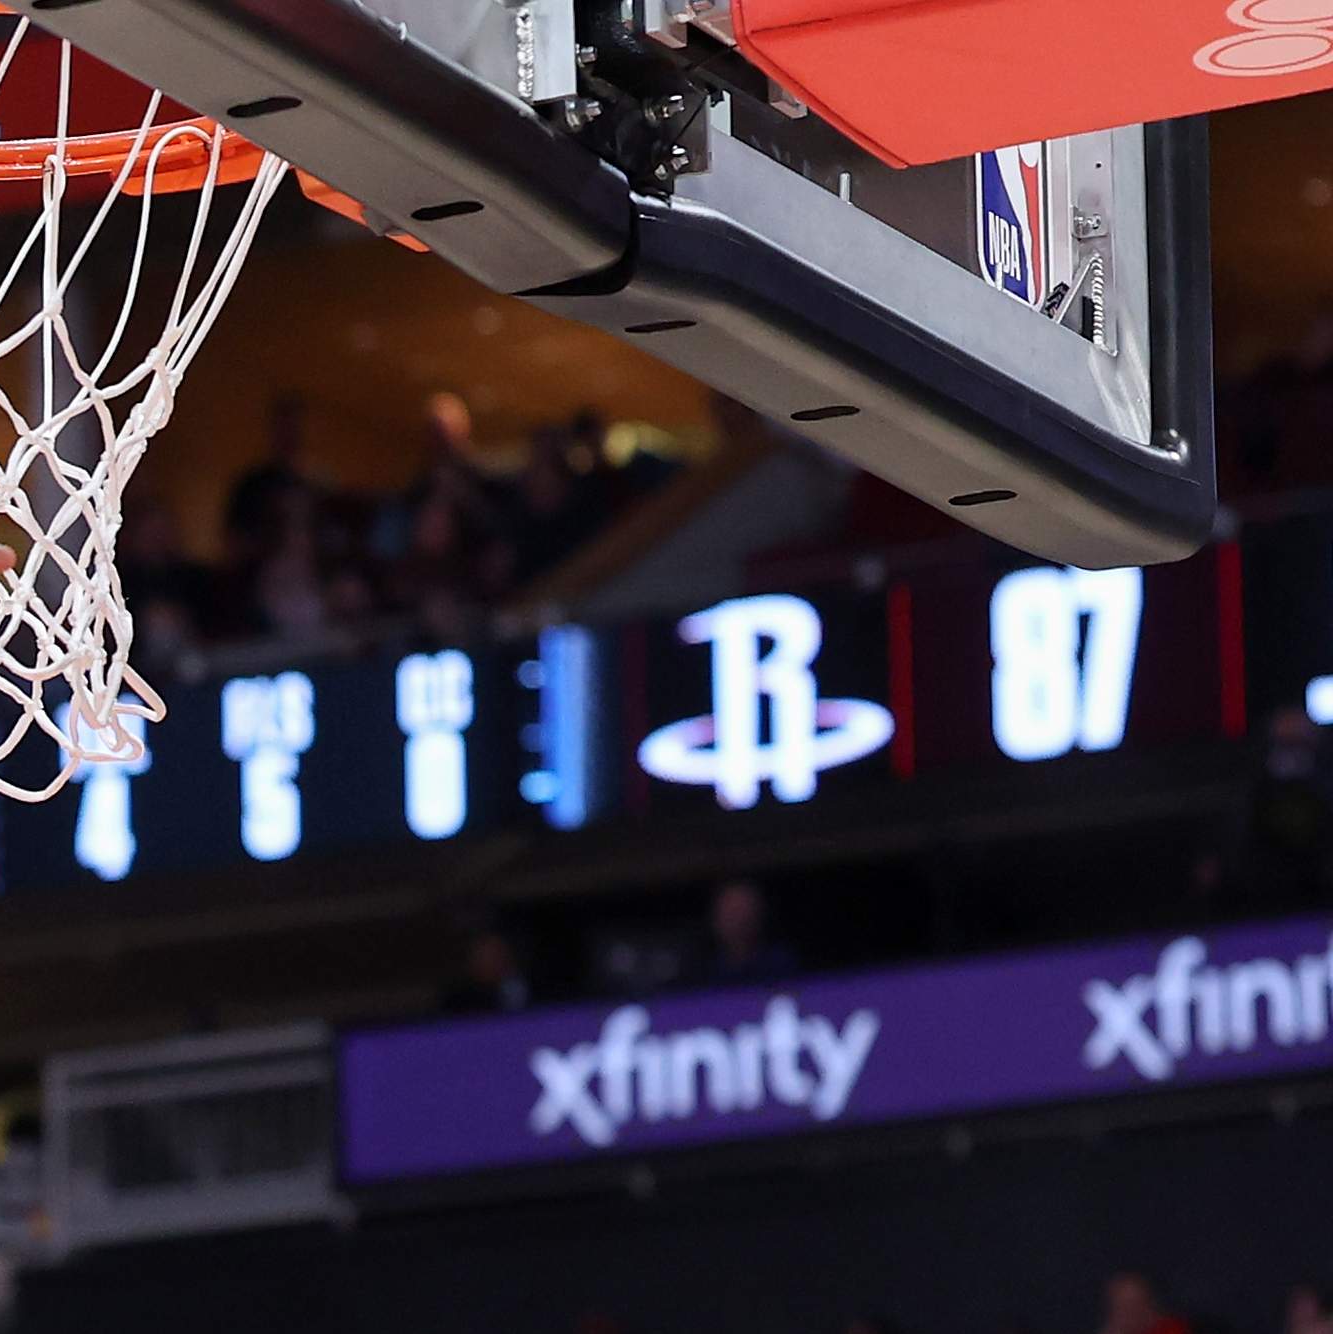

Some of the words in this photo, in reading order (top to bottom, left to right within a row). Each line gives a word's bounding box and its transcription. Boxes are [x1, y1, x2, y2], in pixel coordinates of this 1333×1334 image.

[989, 212, 1022, 281] NBA
[989, 565, 1144, 762] 87
[529, 996, 880, 1147] xfinity
[1083, 934, 1333, 1080] xfini
